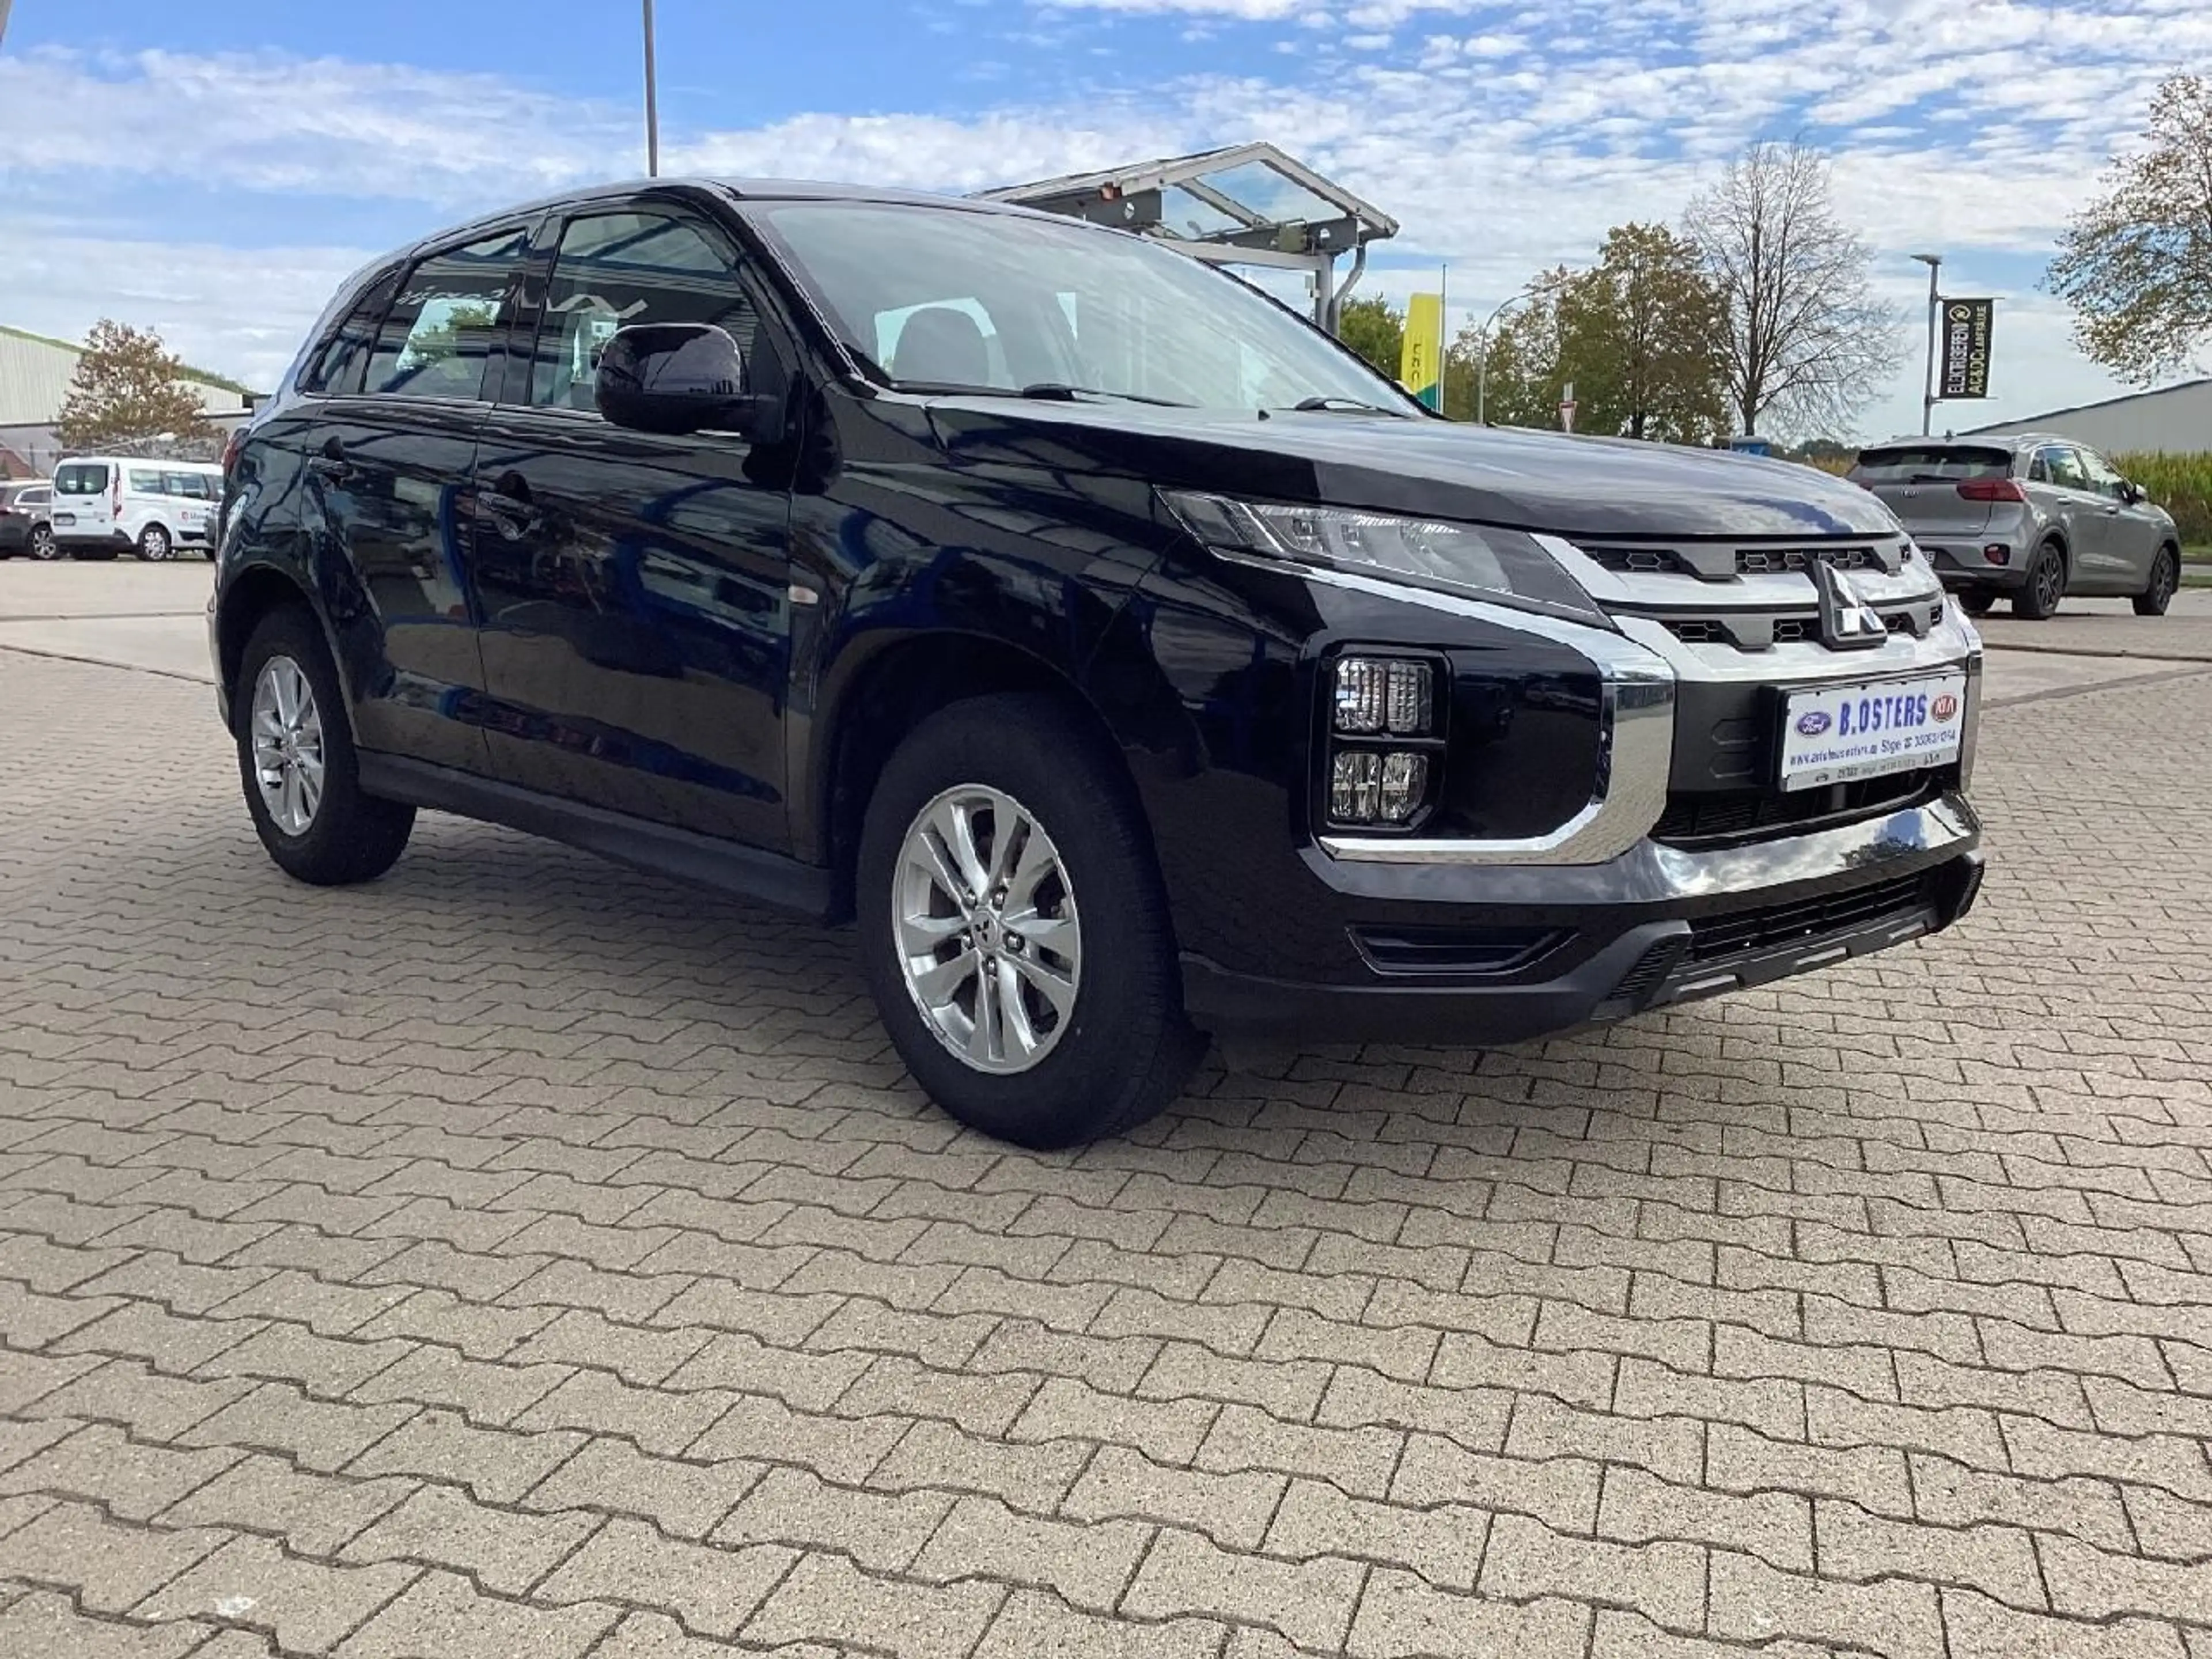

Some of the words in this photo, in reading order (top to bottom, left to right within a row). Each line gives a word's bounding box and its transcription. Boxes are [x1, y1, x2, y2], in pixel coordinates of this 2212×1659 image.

[1936, 697, 1953, 714] KIA
[1804, 715, 1826, 733] Ford
[1839, 695, 1927, 736] B.OSTERS
